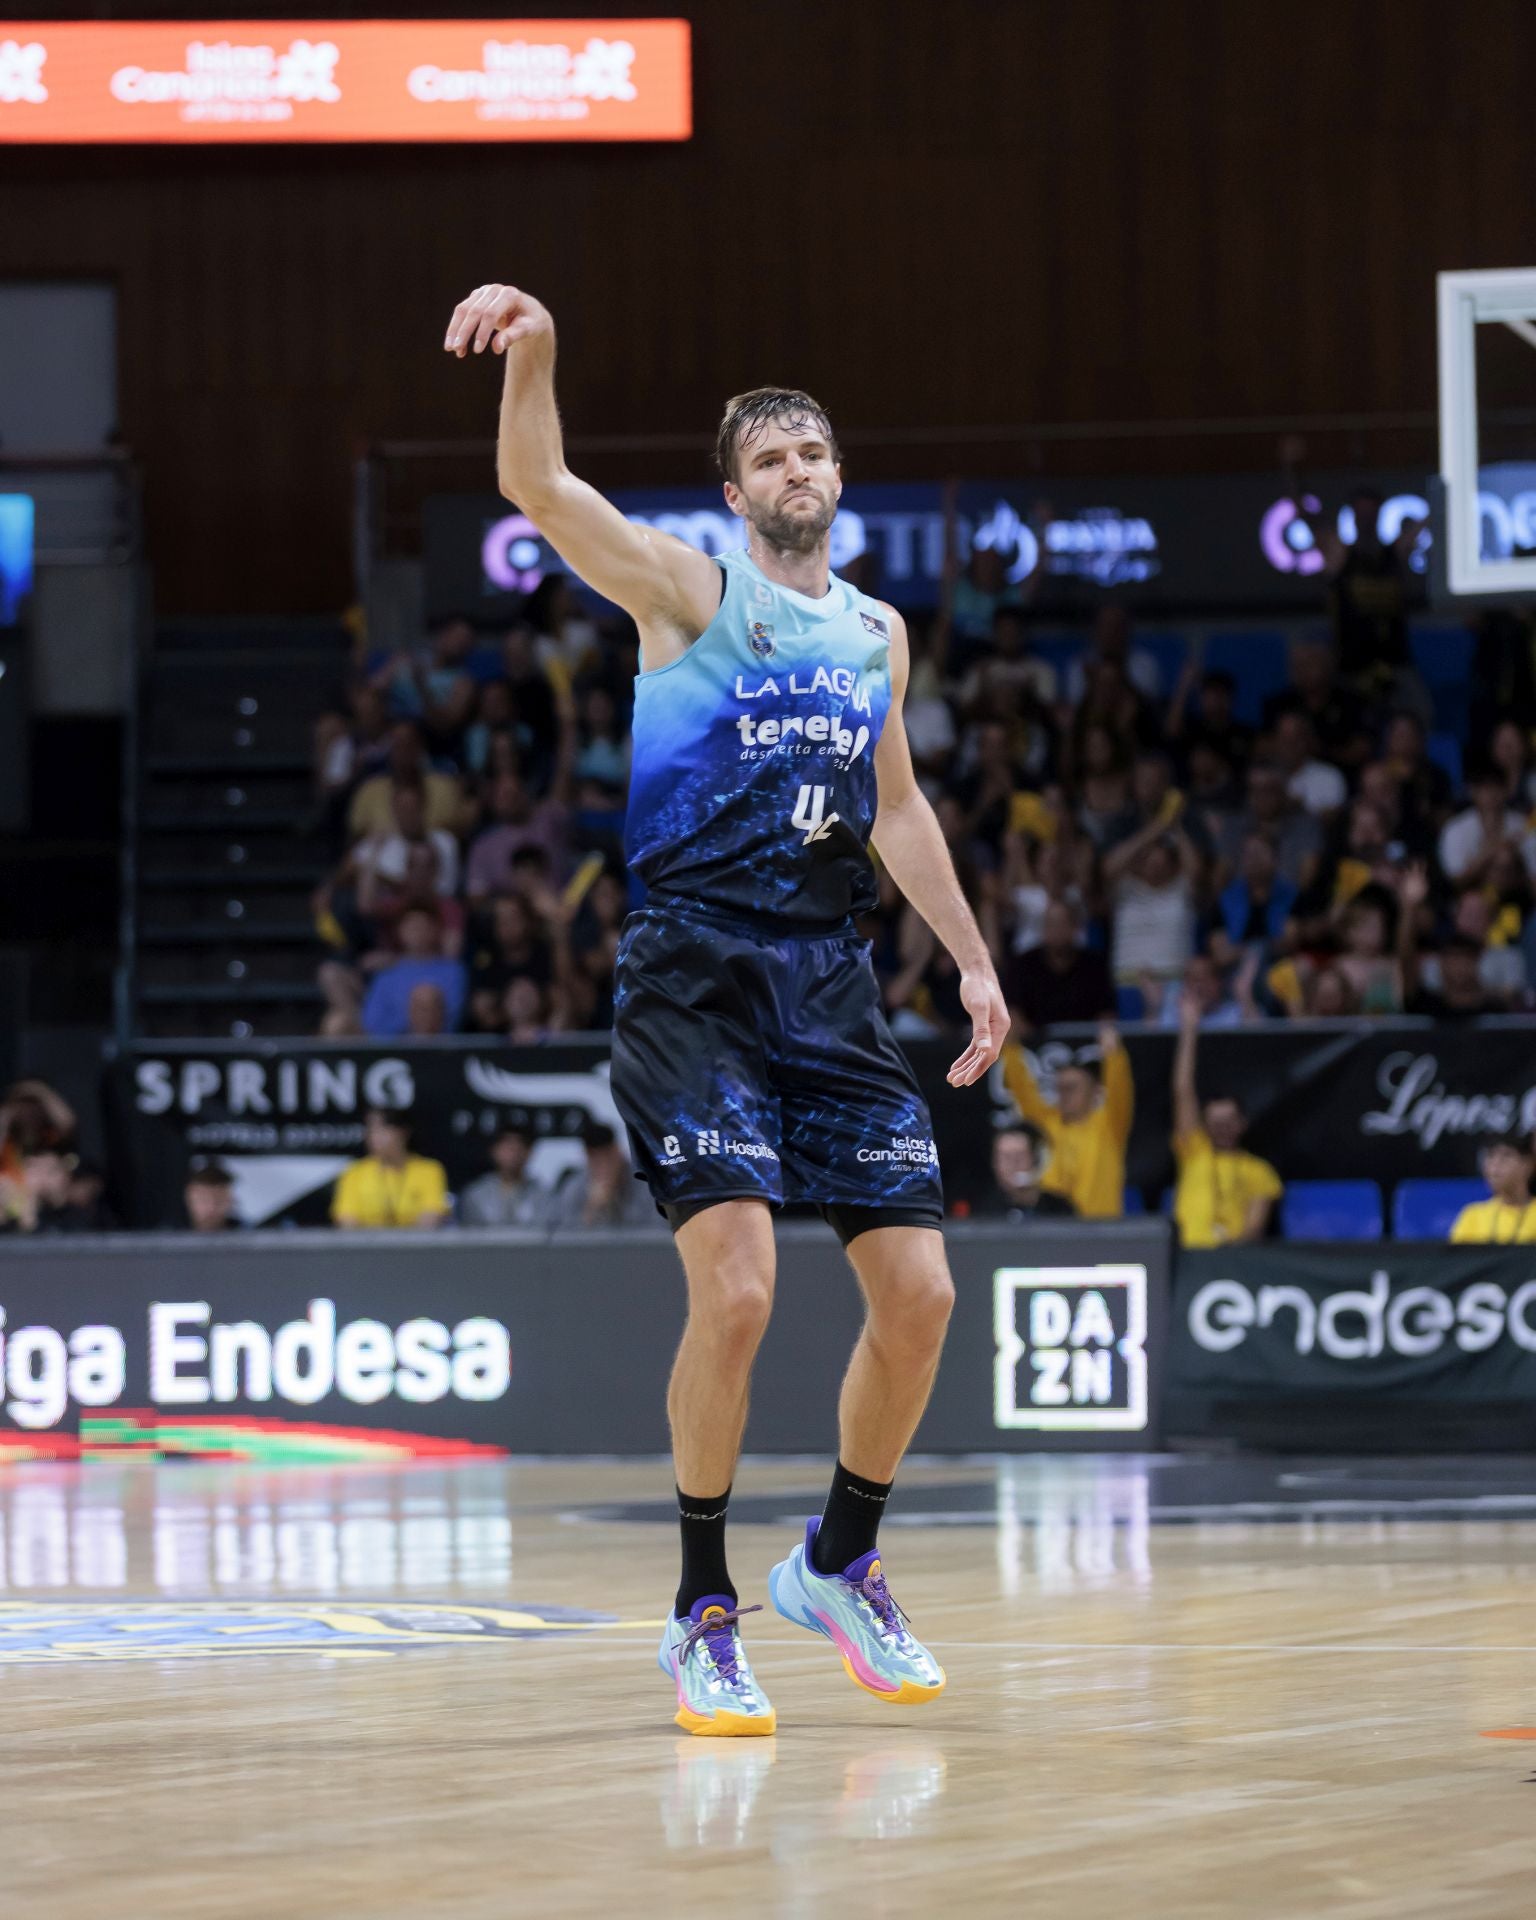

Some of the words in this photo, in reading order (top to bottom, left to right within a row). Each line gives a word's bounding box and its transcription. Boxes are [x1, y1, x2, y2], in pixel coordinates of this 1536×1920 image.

[736, 675, 781, 699] LA
[135, 1058, 416, 1116] SPRING
[856, 1148, 929, 1163] Canarias
[892, 1136, 927, 1151] Islas
[148, 1298, 510, 1404] Endesa
